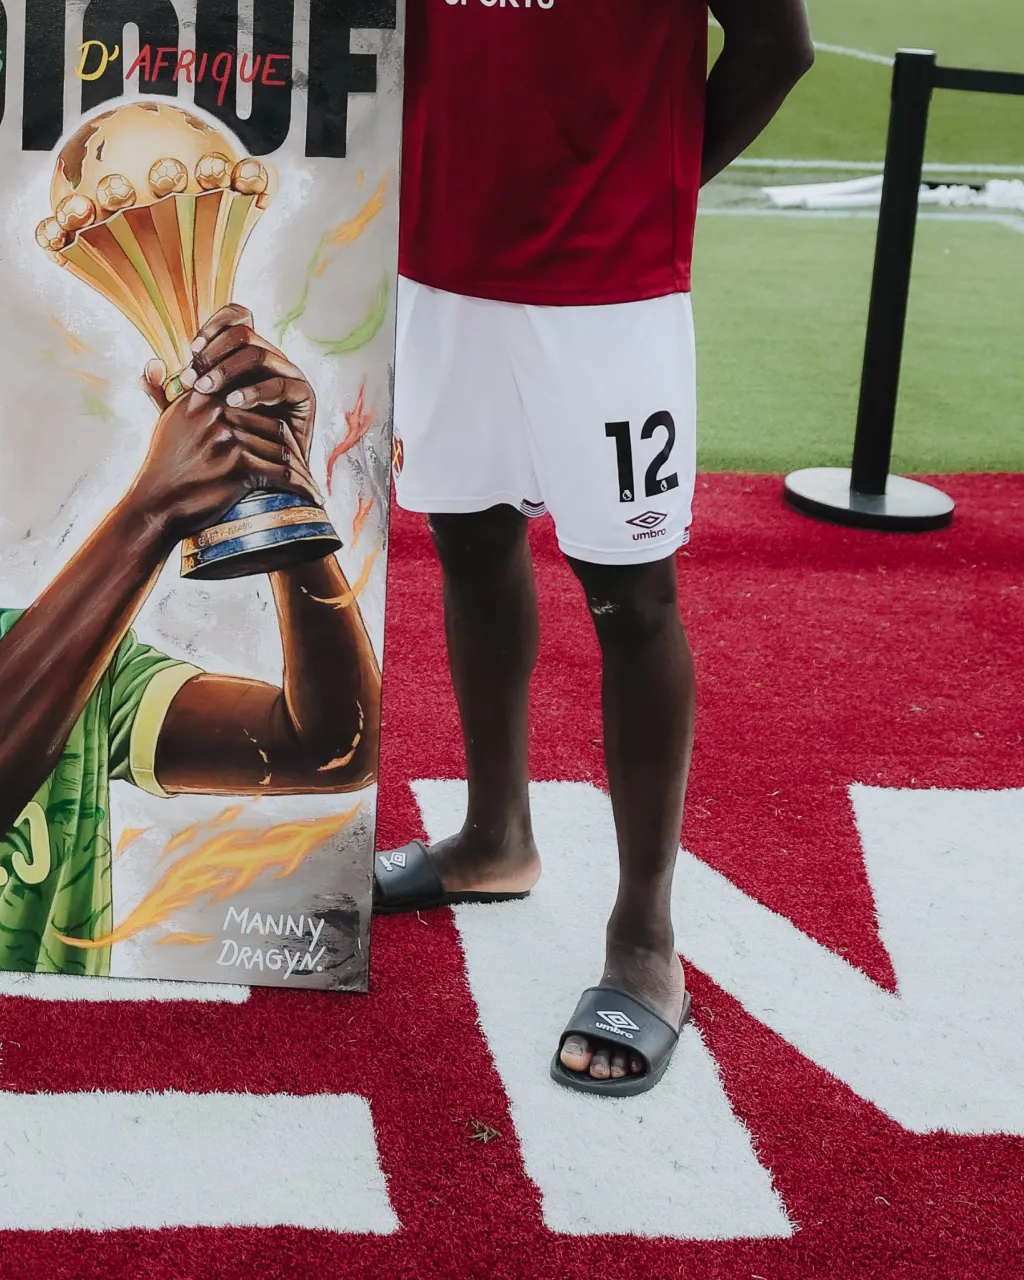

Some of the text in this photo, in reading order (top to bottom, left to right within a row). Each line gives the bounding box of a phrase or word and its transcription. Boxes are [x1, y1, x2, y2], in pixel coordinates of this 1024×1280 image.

[604, 410, 679, 503] 12
[632, 526, 667, 541] umbro
[222, 905, 325, 952] MANNY
[595, 1020, 635, 1040] umbro
